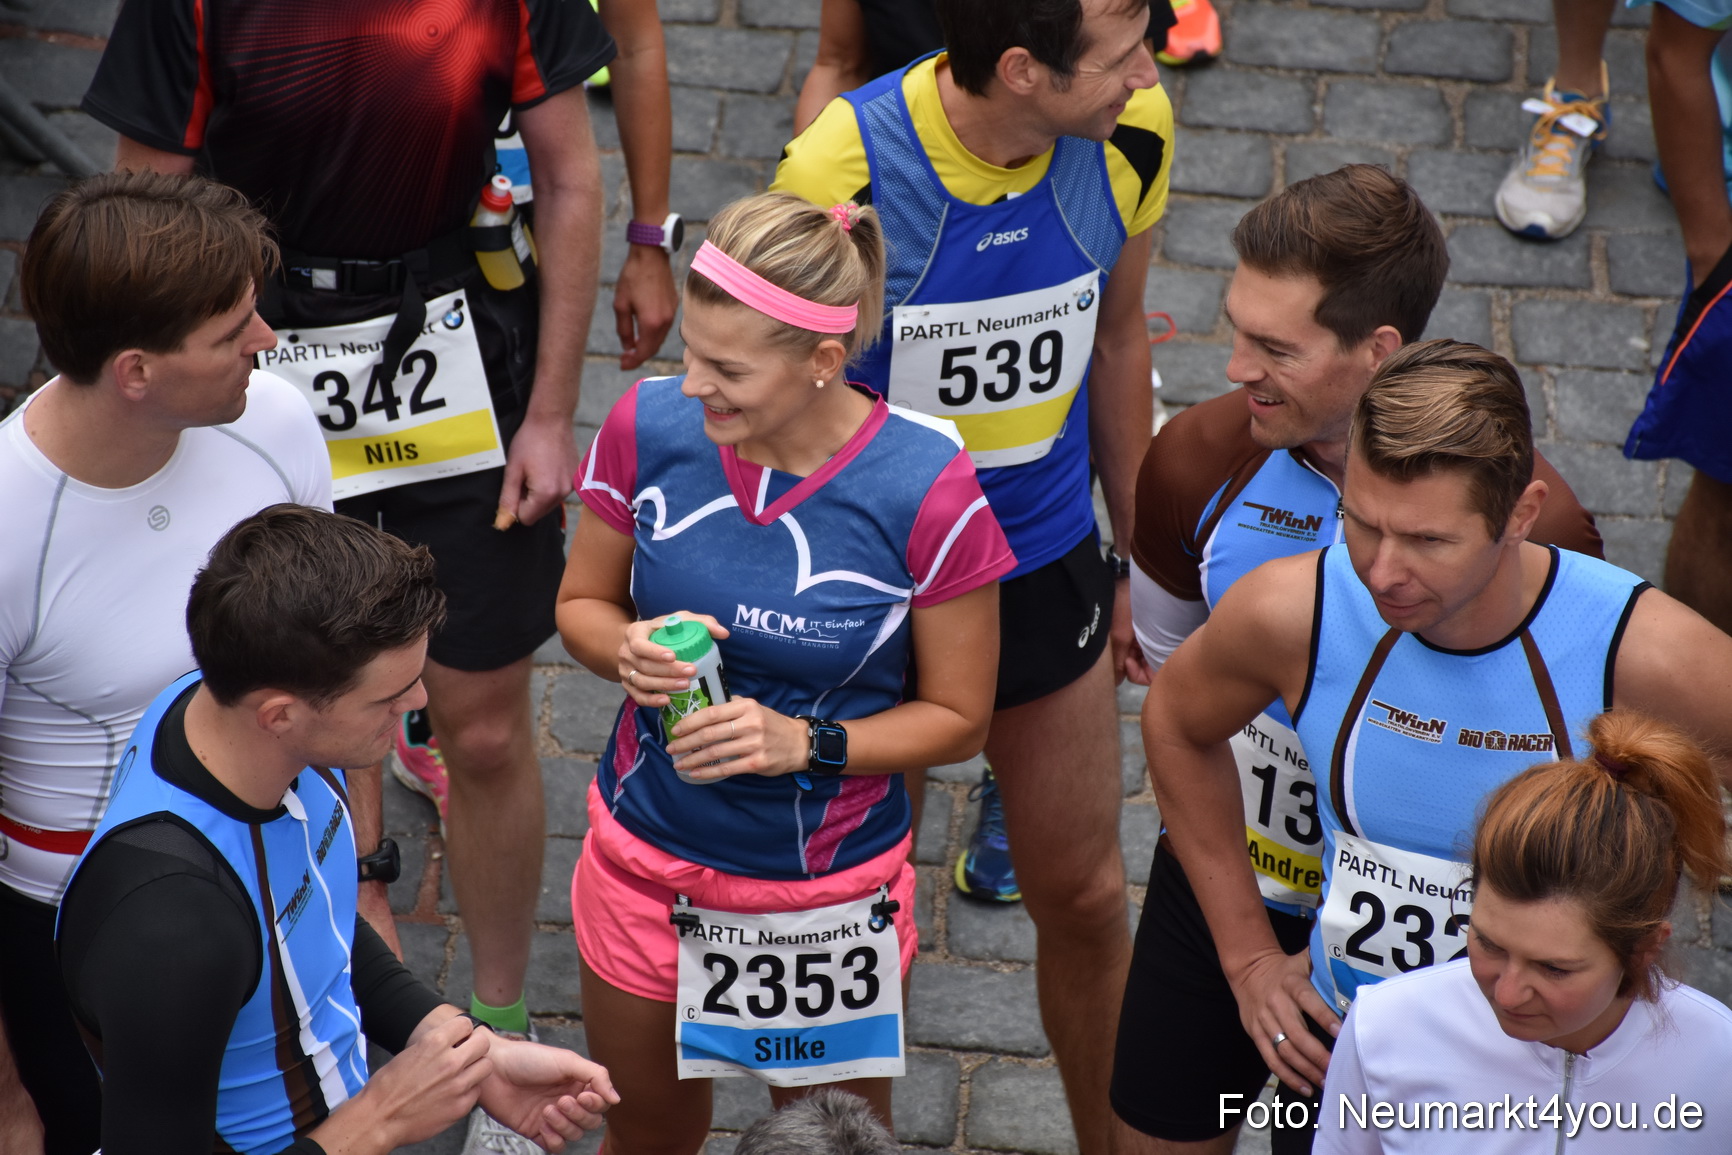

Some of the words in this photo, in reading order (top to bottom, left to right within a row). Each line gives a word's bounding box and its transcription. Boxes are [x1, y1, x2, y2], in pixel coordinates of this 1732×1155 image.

[900, 322, 971, 341] PARTL
[977, 302, 1070, 334] Neumarkt
[265, 343, 336, 366] PARTL
[938, 330, 1063, 406] 539
[313, 349, 447, 432] 342
[364, 441, 419, 465] Nils
[734, 604, 807, 634] MCM
[810, 619, 865, 630] IT-Einfach
[732, 626, 754, 636] MICRO
[759, 632, 797, 644] COMPUTER
[802, 641, 840, 650] MANAGING
[1508, 734, 1554, 752] RACER
[1252, 763, 1324, 846] 13
[1249, 840, 1320, 888] Andre
[1339, 849, 1402, 889] PARTL
[758, 922, 861, 946] Neumarkt
[702, 946, 880, 1019] 2353
[687, 1007, 695, 1020] C
[755, 1036, 826, 1063] Silke
